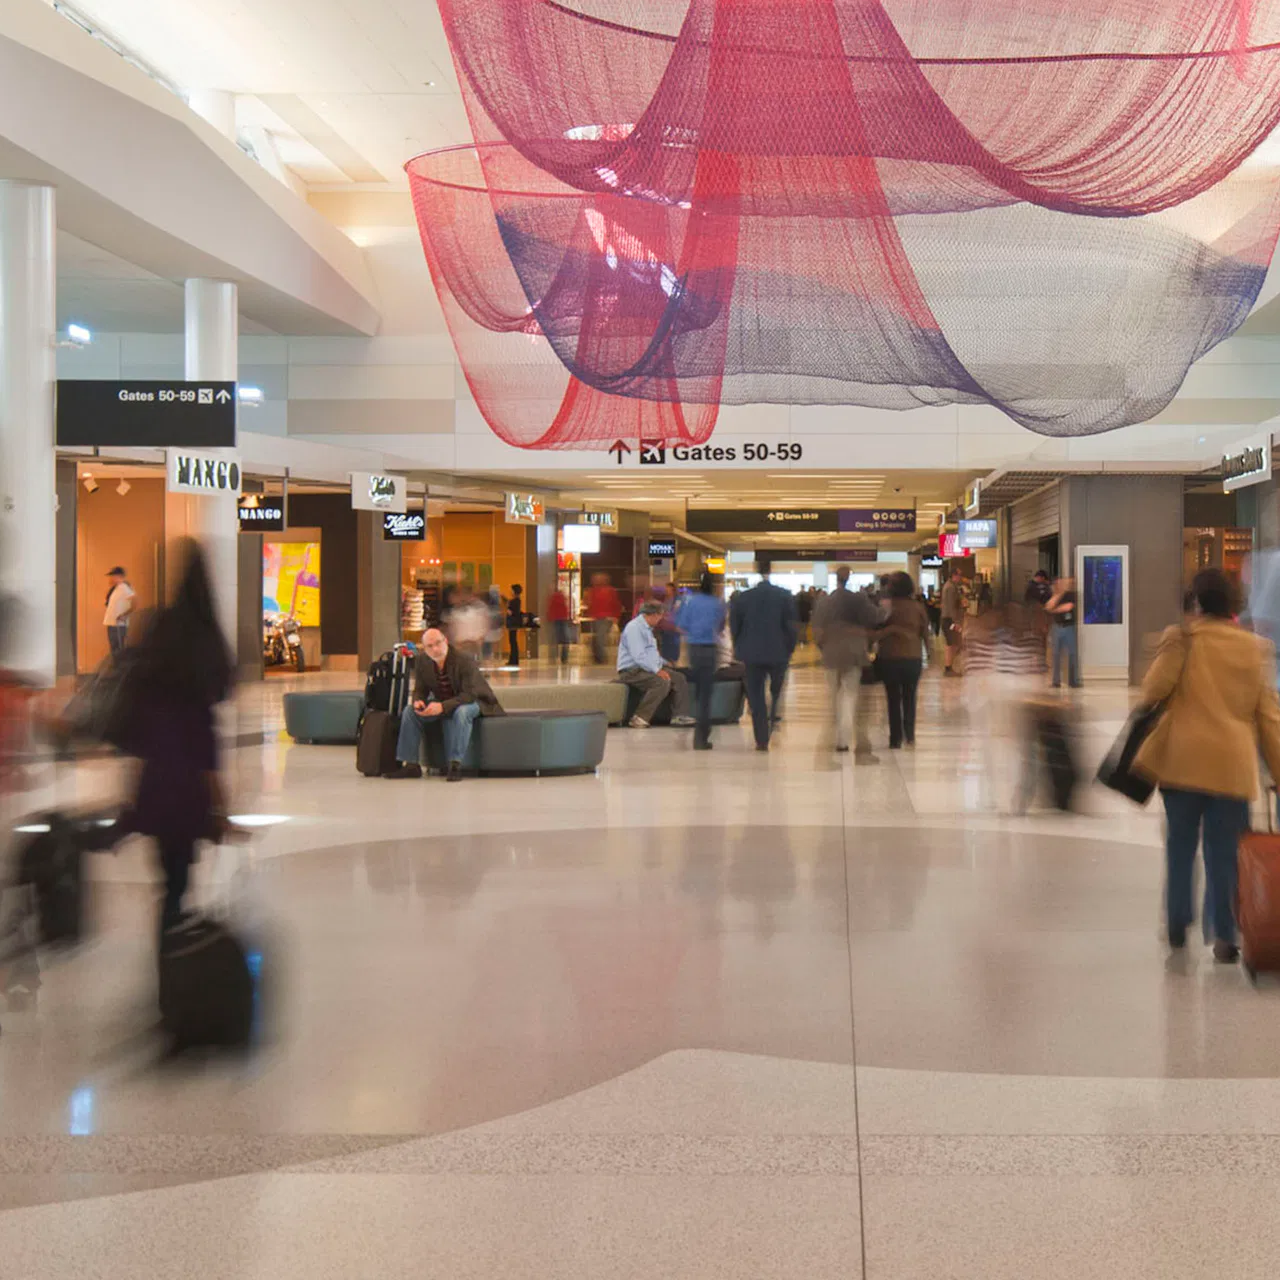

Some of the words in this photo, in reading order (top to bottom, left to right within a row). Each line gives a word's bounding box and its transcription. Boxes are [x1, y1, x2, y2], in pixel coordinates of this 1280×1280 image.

[118, 390, 155, 402] Gates
[159, 391, 196, 402] 50-59
[672, 442, 736, 461] Gates
[743, 443, 802, 461] 50-59
[176, 455, 240, 491] MANGO
[239, 508, 282, 520] MANGO
[383, 514, 424, 529] Kiehl's
